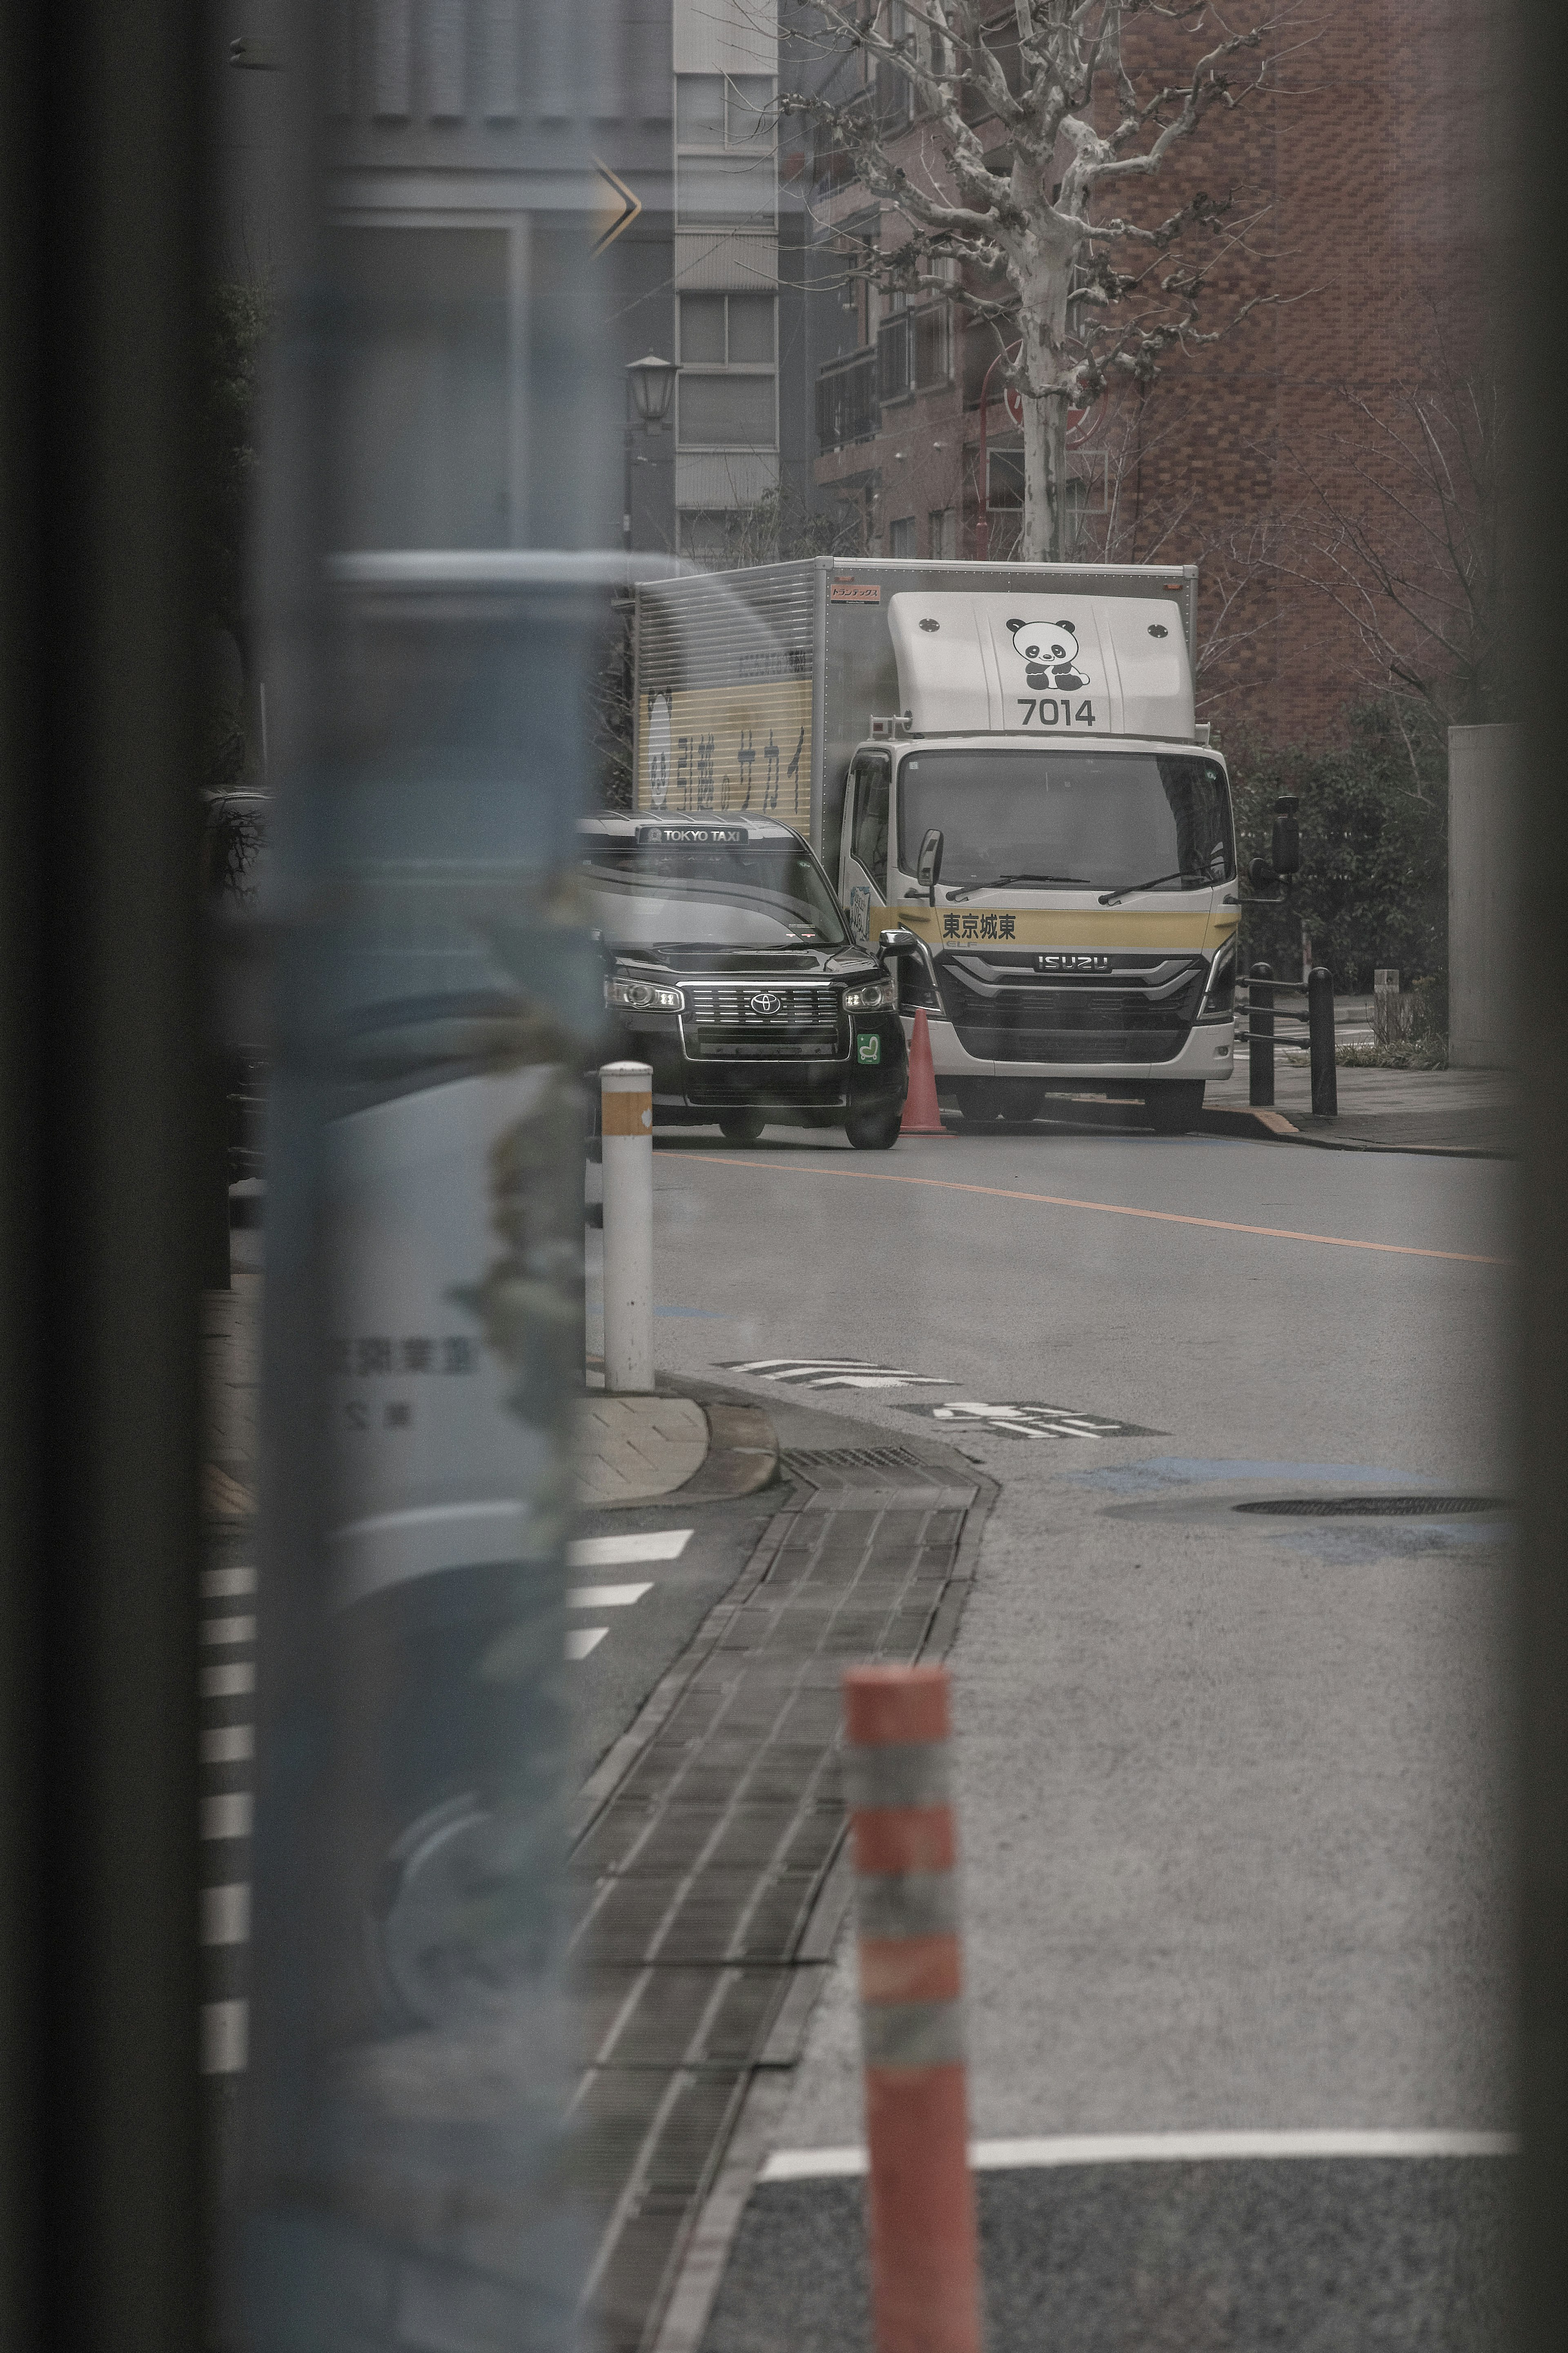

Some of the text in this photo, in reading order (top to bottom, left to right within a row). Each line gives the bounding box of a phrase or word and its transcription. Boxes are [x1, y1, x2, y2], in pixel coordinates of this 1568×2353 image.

[833, 589, 878, 597] トランテックス
[1017, 698, 1096, 726] 7014
[664, 830, 740, 841] TOKYO TAXI
[943, 912, 1016, 940] 東京城東
[1038, 956, 1108, 970] ISUZU
